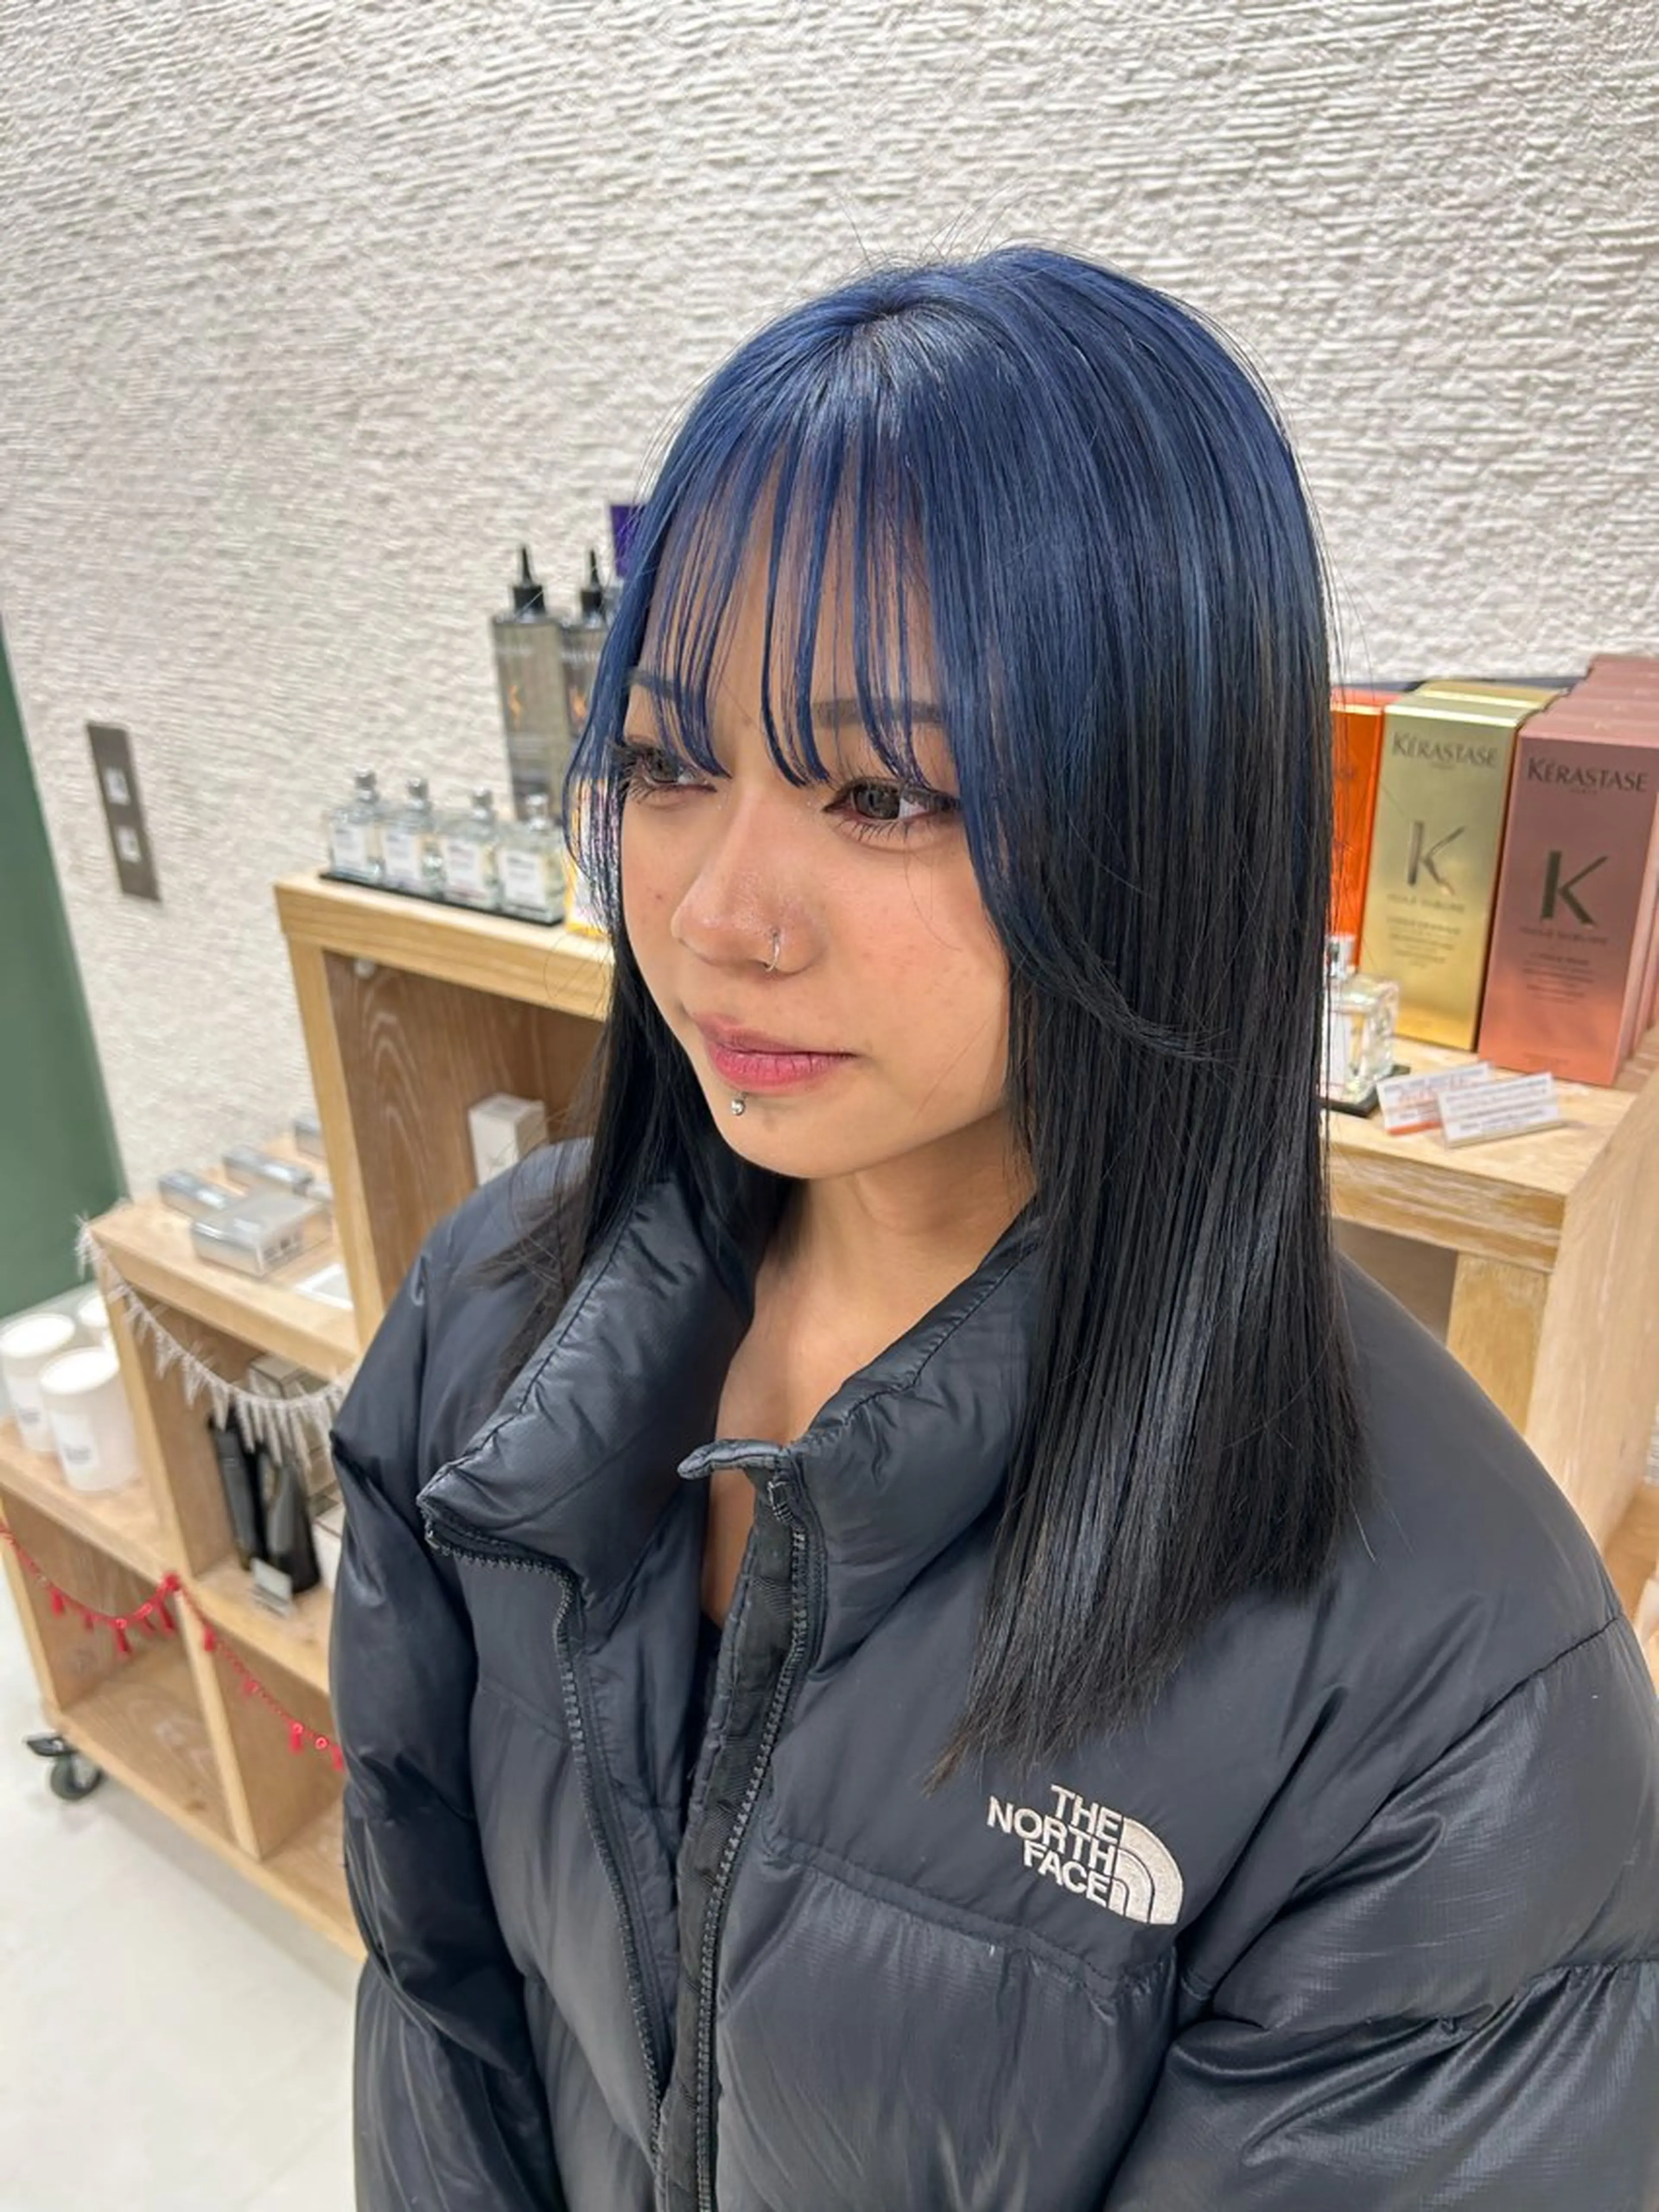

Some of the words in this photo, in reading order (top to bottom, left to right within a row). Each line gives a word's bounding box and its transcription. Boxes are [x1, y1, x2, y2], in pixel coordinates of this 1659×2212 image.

[1407, 820, 1466, 895] K
[1541, 850, 1608, 925] K
[987, 1796, 1115, 1876] NORTH
[1050, 1784, 1122, 1844] THE
[1023, 1840, 1111, 1908] FACE
